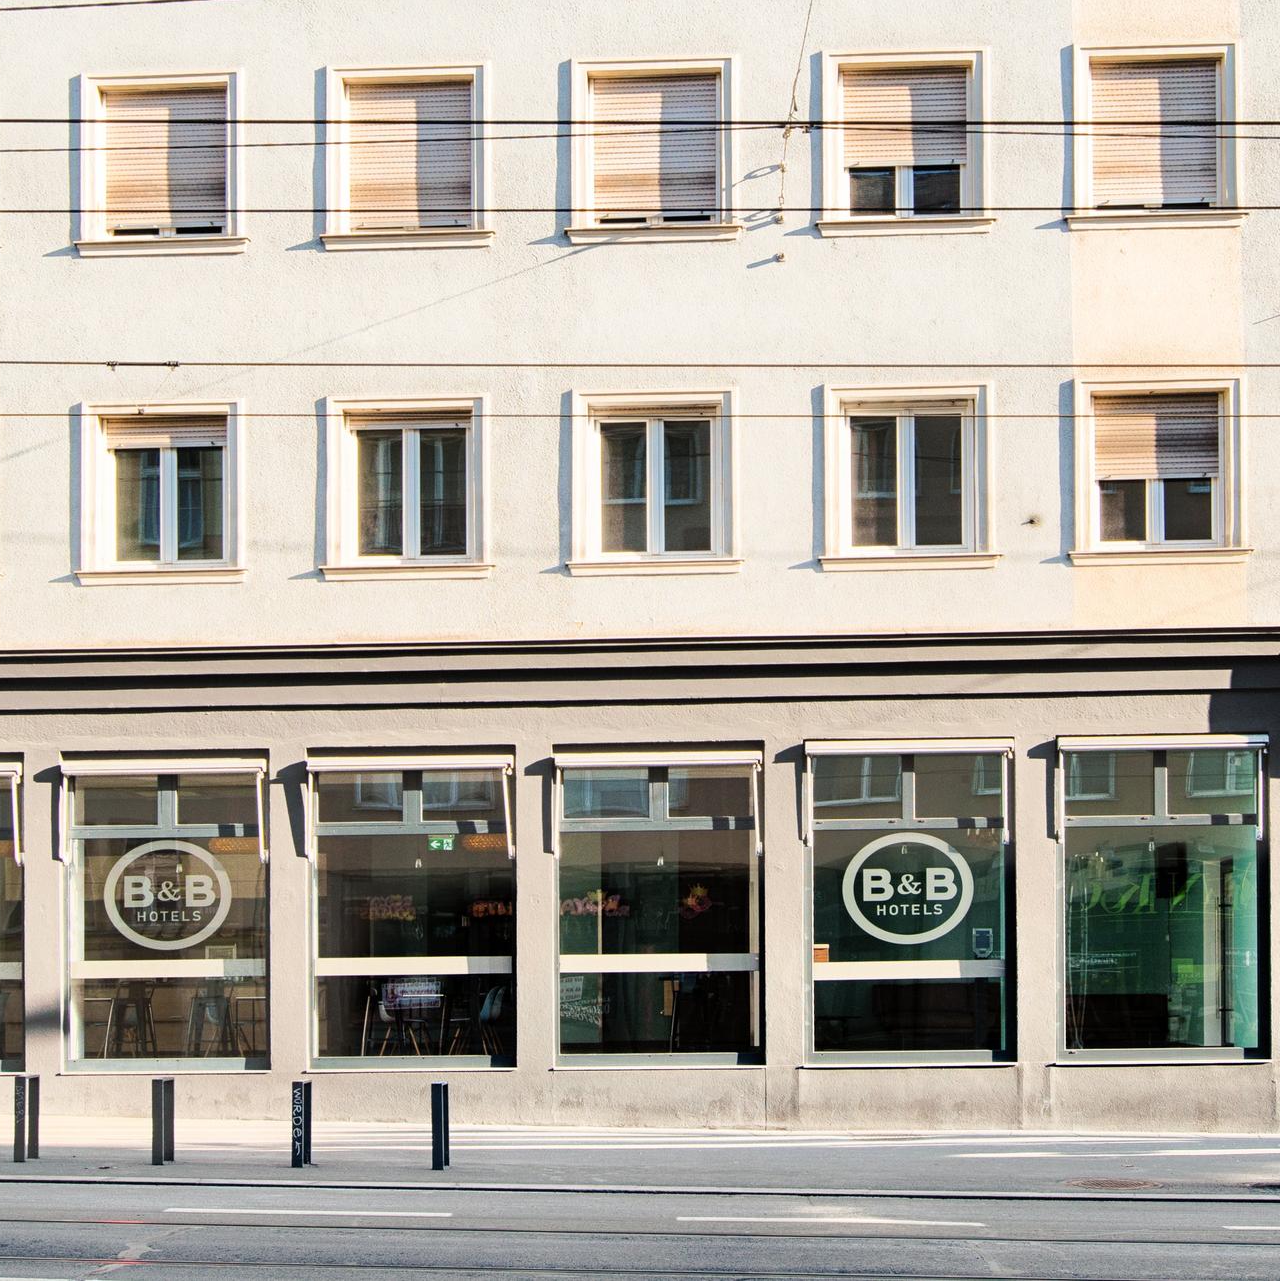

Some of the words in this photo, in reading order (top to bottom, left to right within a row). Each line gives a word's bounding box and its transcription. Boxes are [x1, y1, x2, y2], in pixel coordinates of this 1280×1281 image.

[123, 875, 216, 908] B&B
[863, 867, 958, 902] B&B
[137, 911, 202, 922] HOTELS
[876, 904, 943, 916] HOTELS
